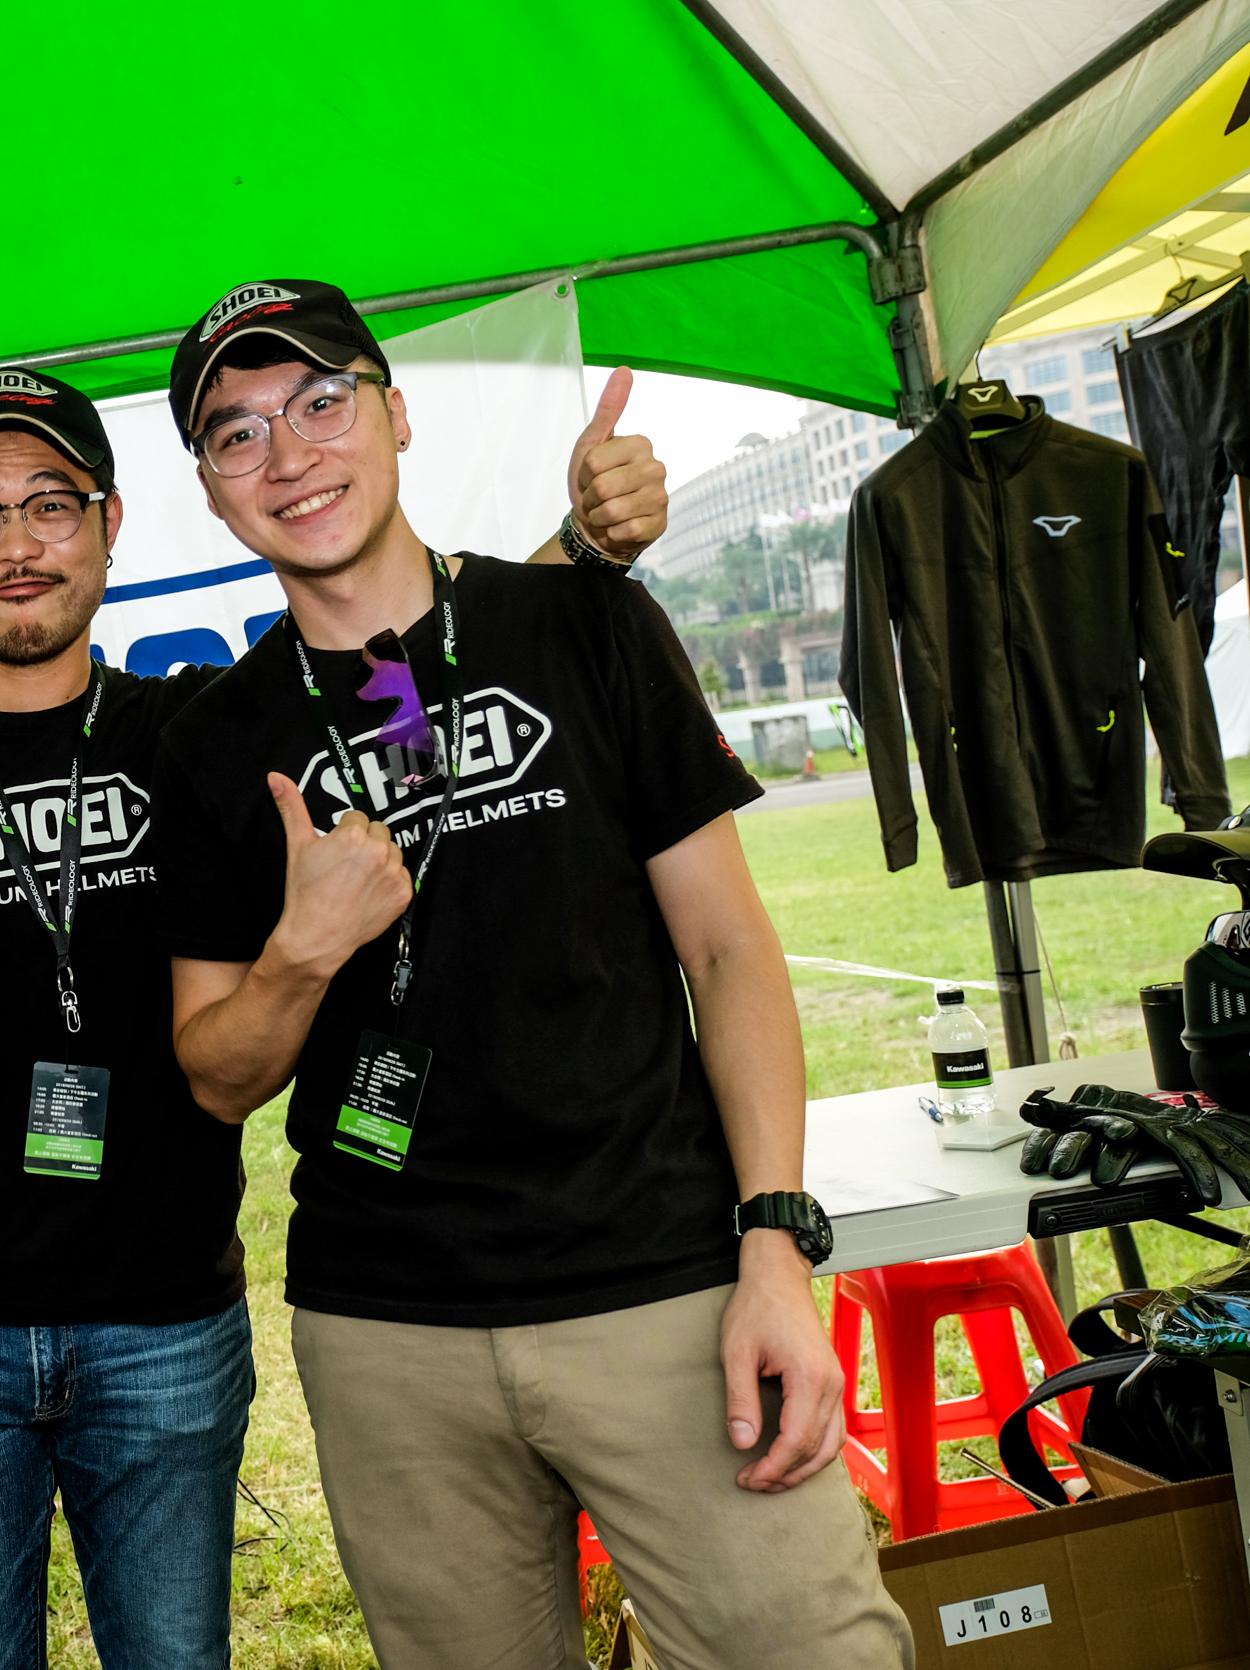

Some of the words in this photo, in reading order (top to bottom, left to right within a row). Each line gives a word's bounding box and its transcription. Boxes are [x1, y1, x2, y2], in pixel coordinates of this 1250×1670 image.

[210, 287, 281, 328] SHOEI
[443, 601, 454, 639] RIDEOLOGY
[92, 682, 103, 716] RIDEOLOGY
[452, 698, 460, 747] RIDEOLOGY
[327, 725, 351, 768] RIDEOLOGY
[21, 865, 43, 908] RIDEOLOGY
[46, 866, 157, 896] HLMETS
[68, 860, 76, 906] RIDEOLOGY
[946, 1061, 985, 1074] Kawasaki
[71, 1163, 97, 1172] Kawasaki
